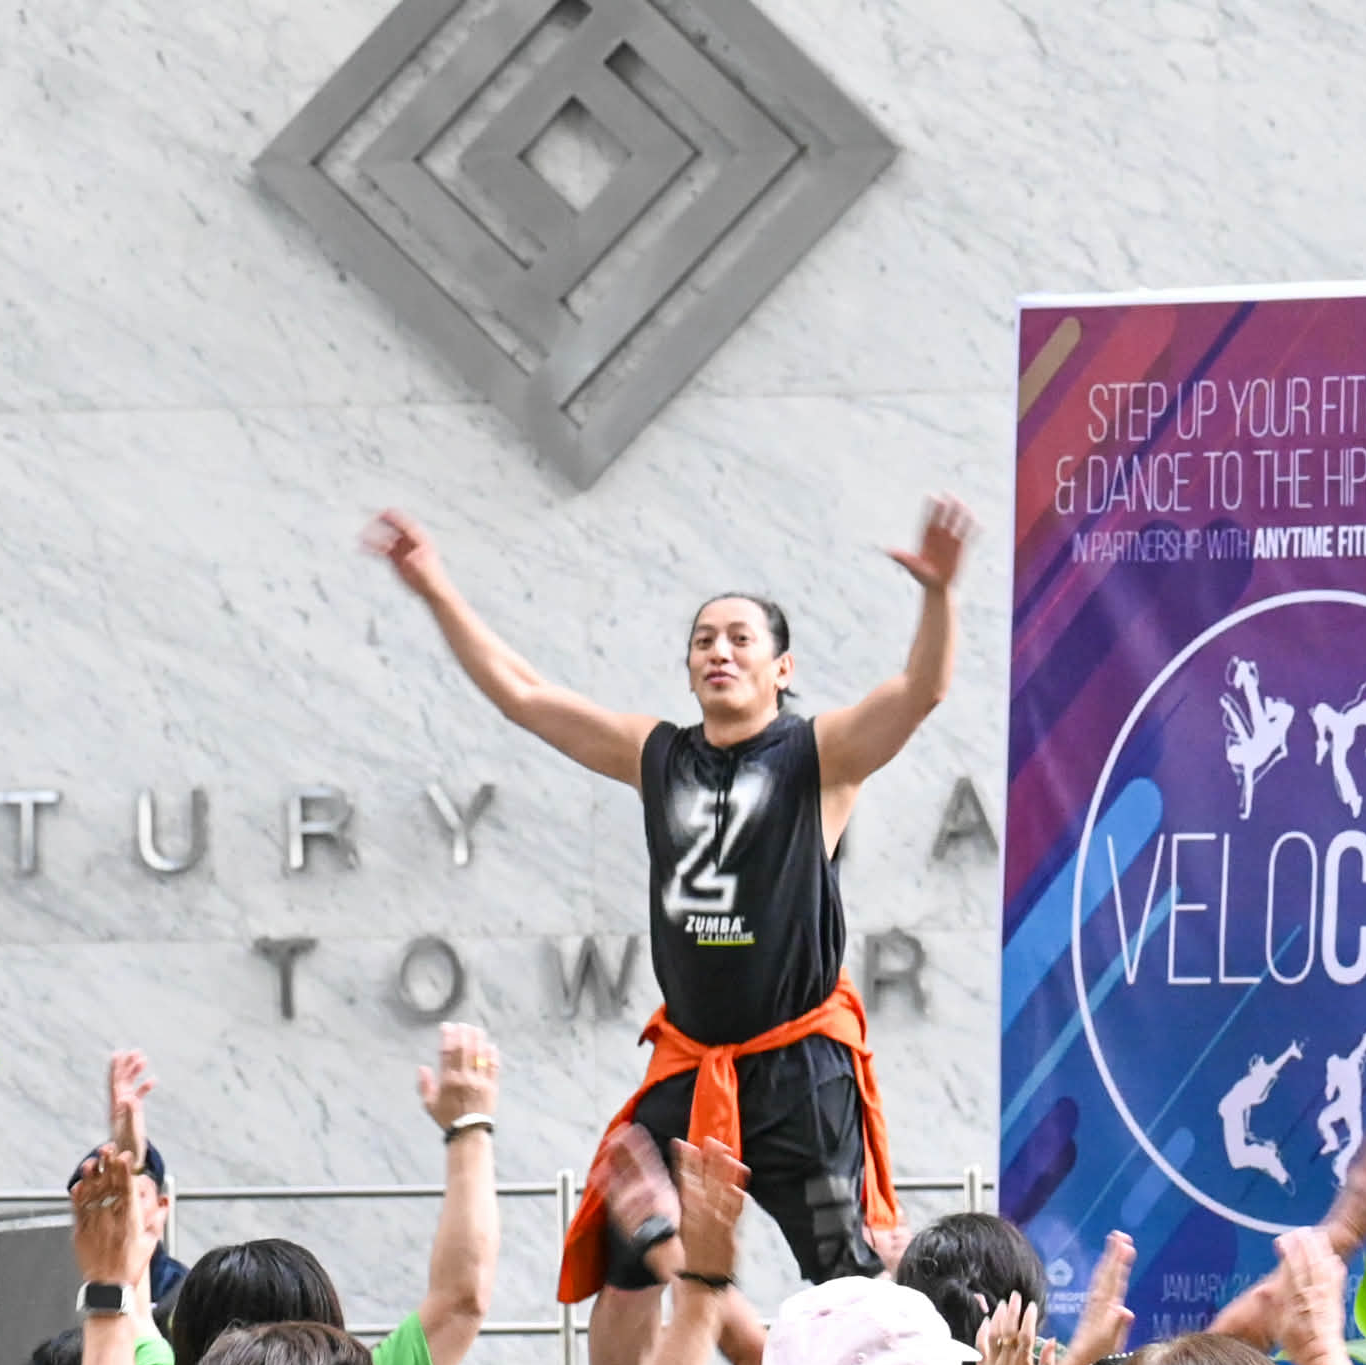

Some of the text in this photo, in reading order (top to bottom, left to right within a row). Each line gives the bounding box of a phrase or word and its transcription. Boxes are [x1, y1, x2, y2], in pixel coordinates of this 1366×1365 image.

[1087, 381, 1167, 443] STEP
[1176, 380, 1217, 440] UP
[1228, 376, 1311, 438] YOUR
[1054, 455, 1076, 515] &
[1086, 451, 1192, 514] DANCE
[1203, 450, 1242, 511] TO
[1253, 449, 1313, 509] THE
[1090, 528, 1203, 563] PARTNERSHIP
[1206, 527, 1251, 560] WITH
[1252, 525, 1334, 559] ANYTIME
[684, 914, 743, 934] ZUMBA
[253, 930, 929, 1020] TOWR
[1161, 1272, 1227, 1303] JANUARY
